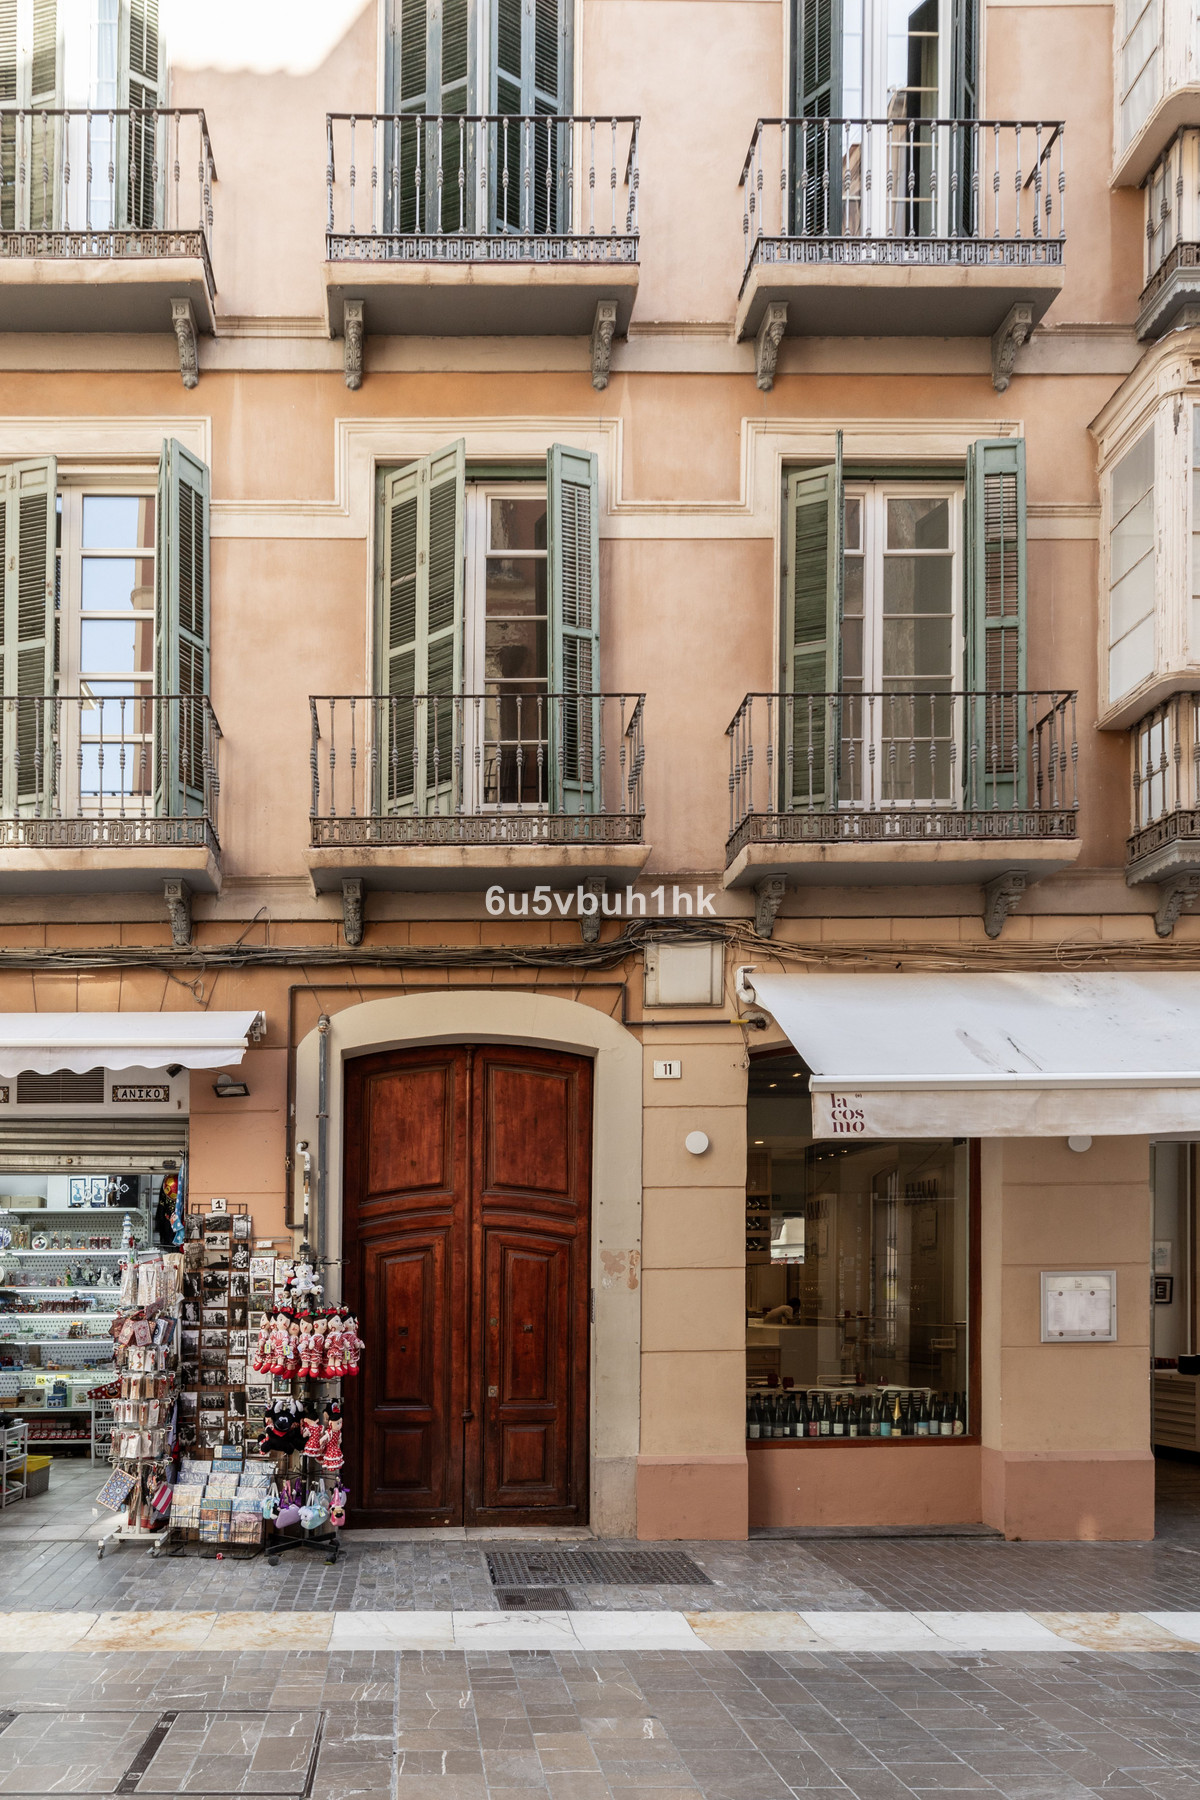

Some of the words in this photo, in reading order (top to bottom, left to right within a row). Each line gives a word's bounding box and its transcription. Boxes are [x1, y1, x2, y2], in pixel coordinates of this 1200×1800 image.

[663, 1063, 672, 1075] 11
[121, 1089, 161, 1099] ANIKO
[830, 1093, 847, 1108] la
[831, 1109, 865, 1120] cos
[833, 1121, 865, 1133] mo
